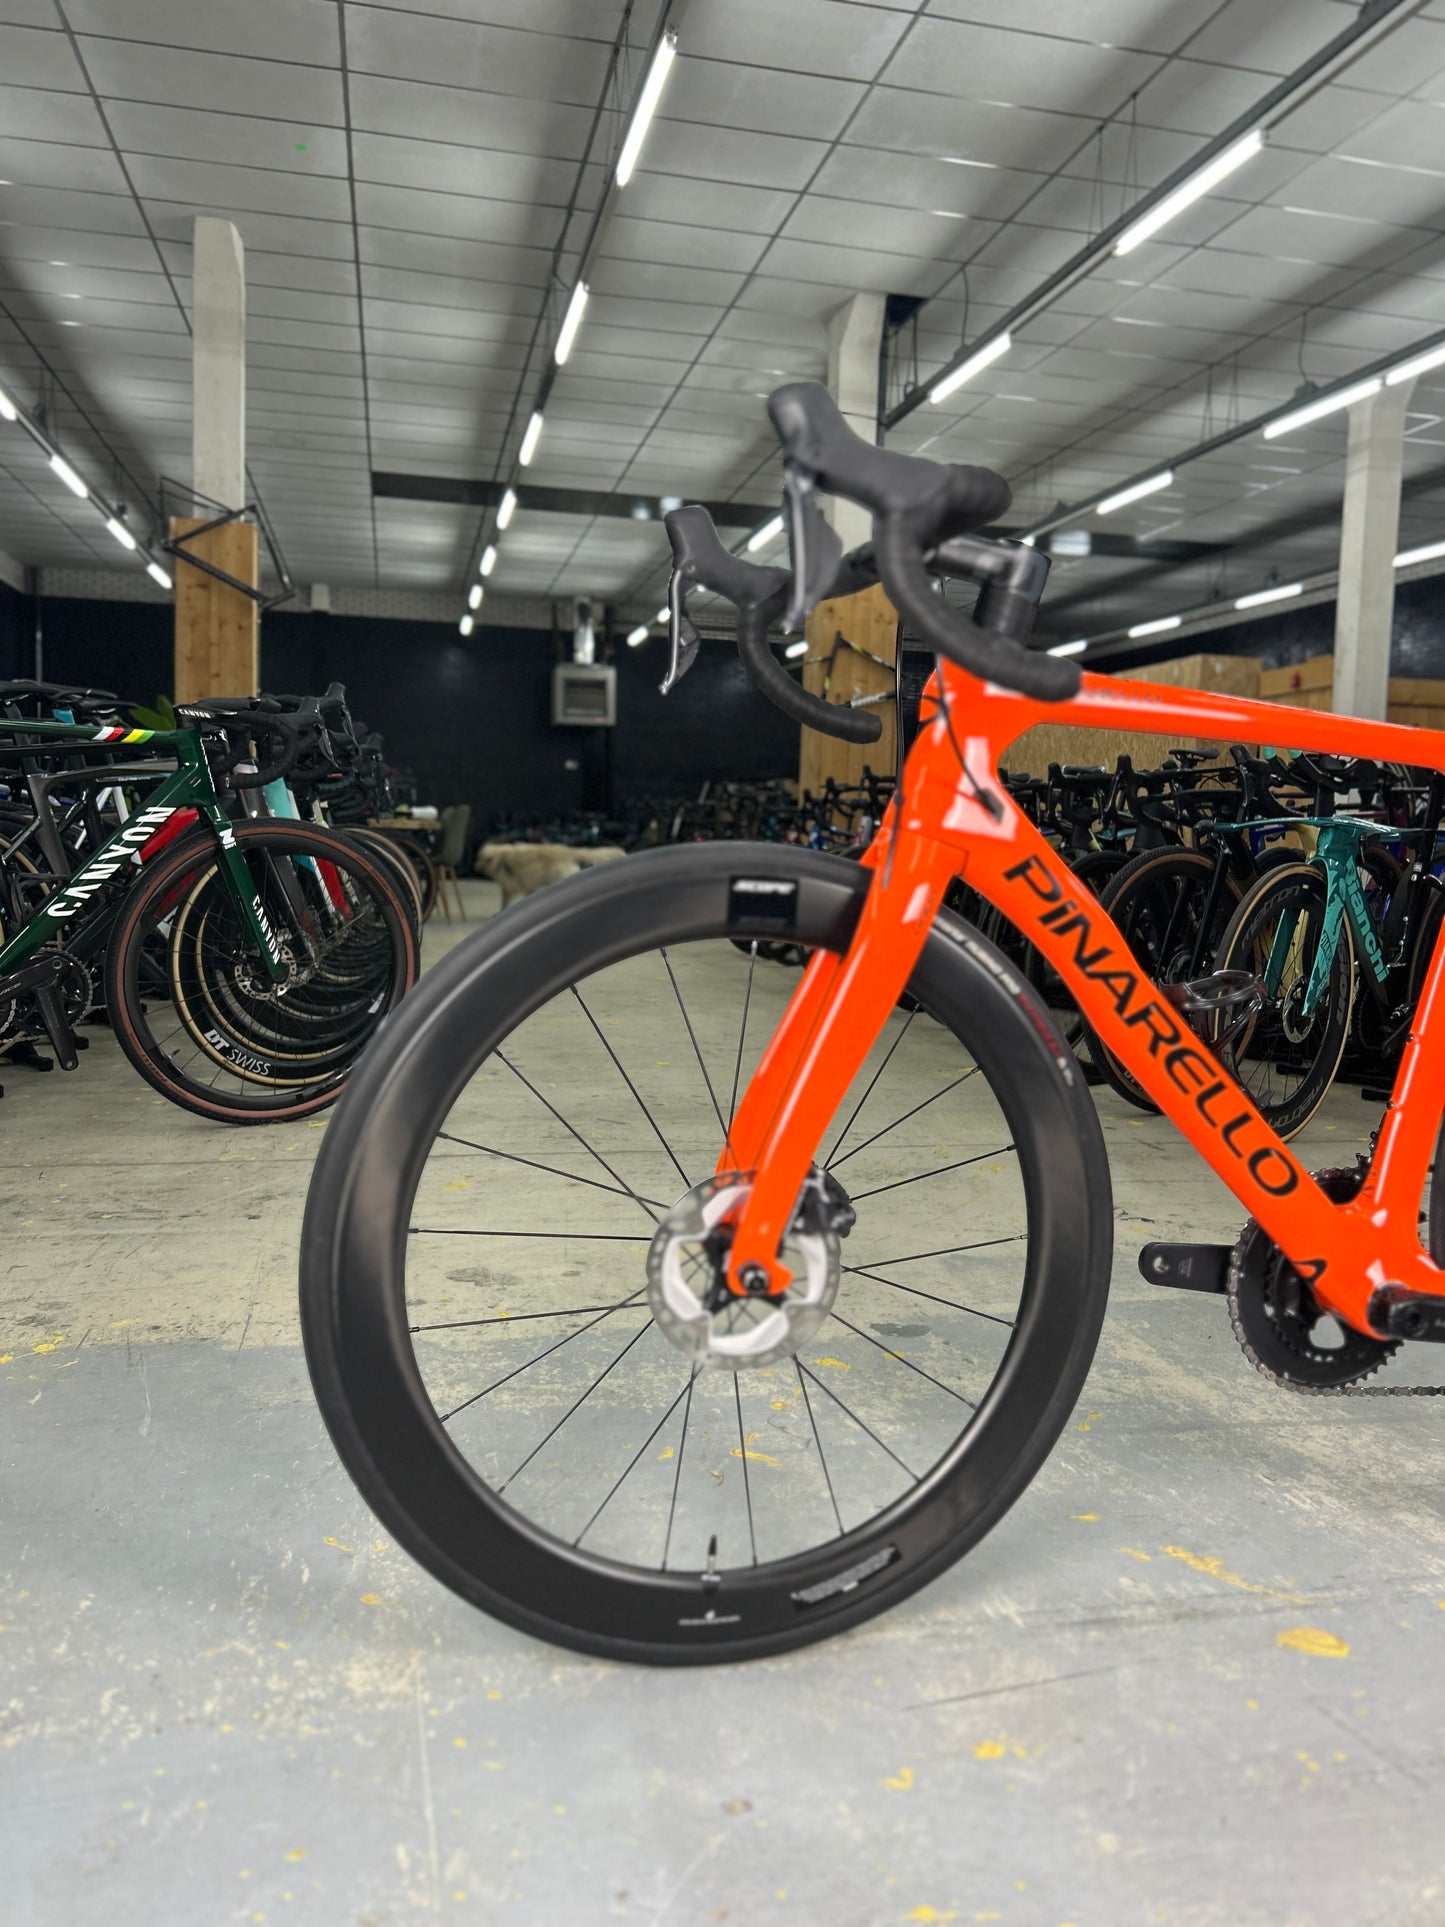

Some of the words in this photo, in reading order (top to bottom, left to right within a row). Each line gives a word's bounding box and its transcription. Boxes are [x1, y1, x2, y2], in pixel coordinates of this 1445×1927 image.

[179, 708, 212, 719] CANYON
[47, 806, 177, 917] CANYON
[252, 894, 281, 966] CANYON
[1345, 855, 1390, 983] Bianchi
[204, 1029, 230, 1051] DT
[226, 1048, 272, 1076] SWISS
